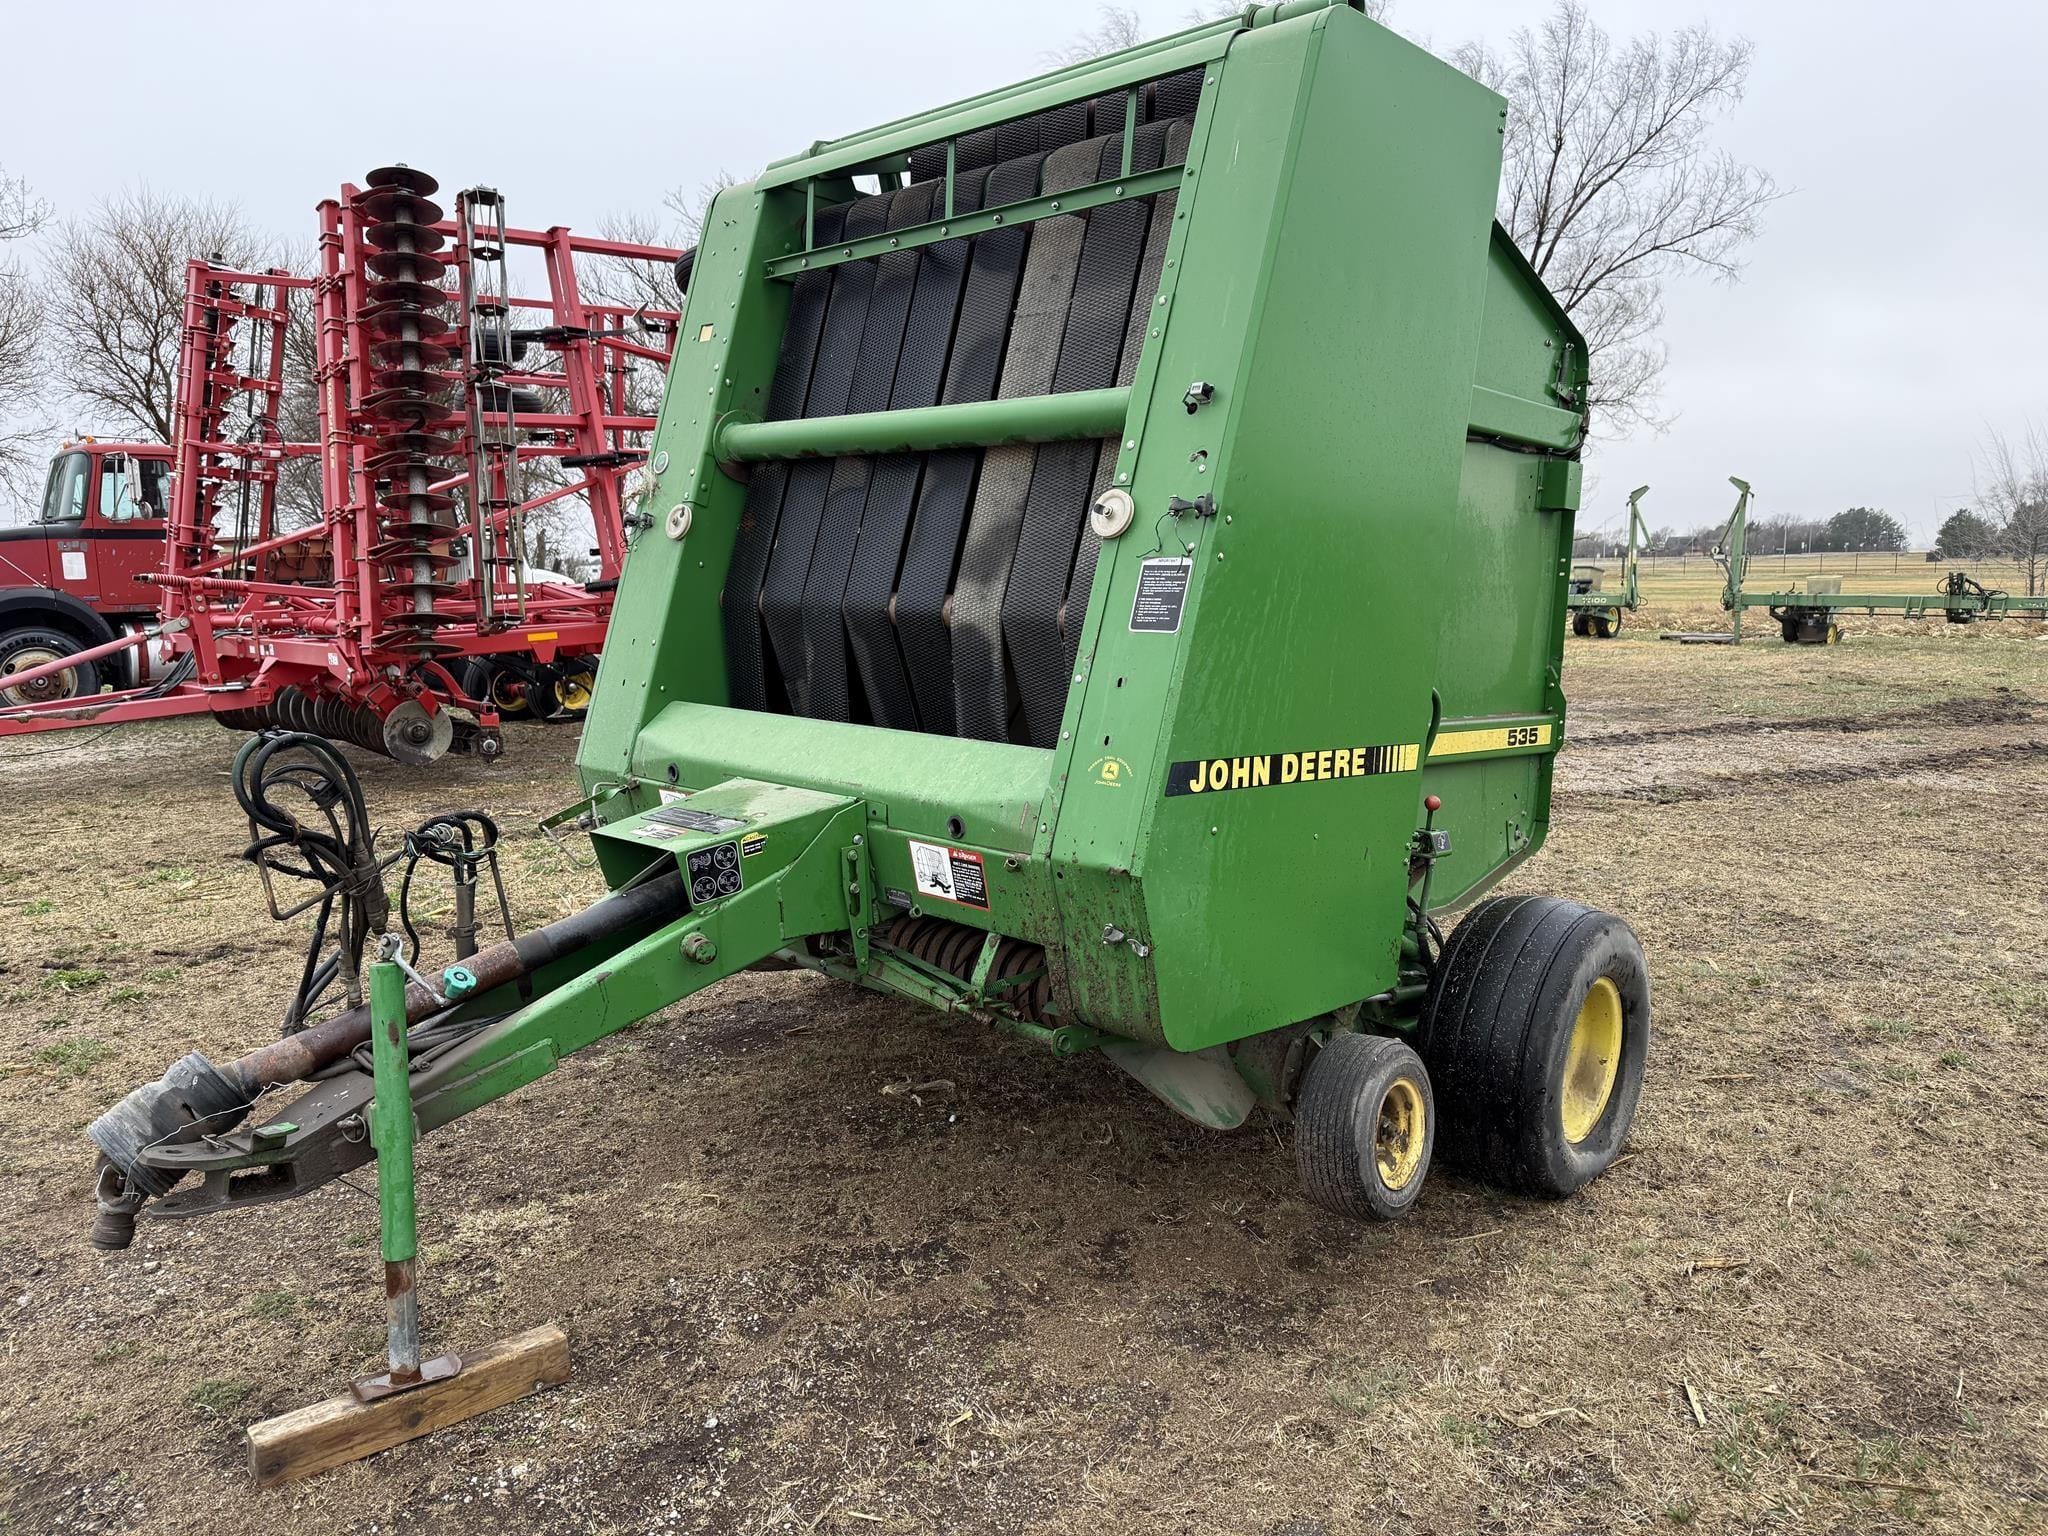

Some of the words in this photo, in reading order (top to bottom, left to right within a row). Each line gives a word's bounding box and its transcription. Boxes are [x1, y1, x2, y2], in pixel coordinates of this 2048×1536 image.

[1508, 727, 1538, 746] 535
[1189, 755, 1271, 793] JOHN
[1281, 747, 1366, 783] DEERE
